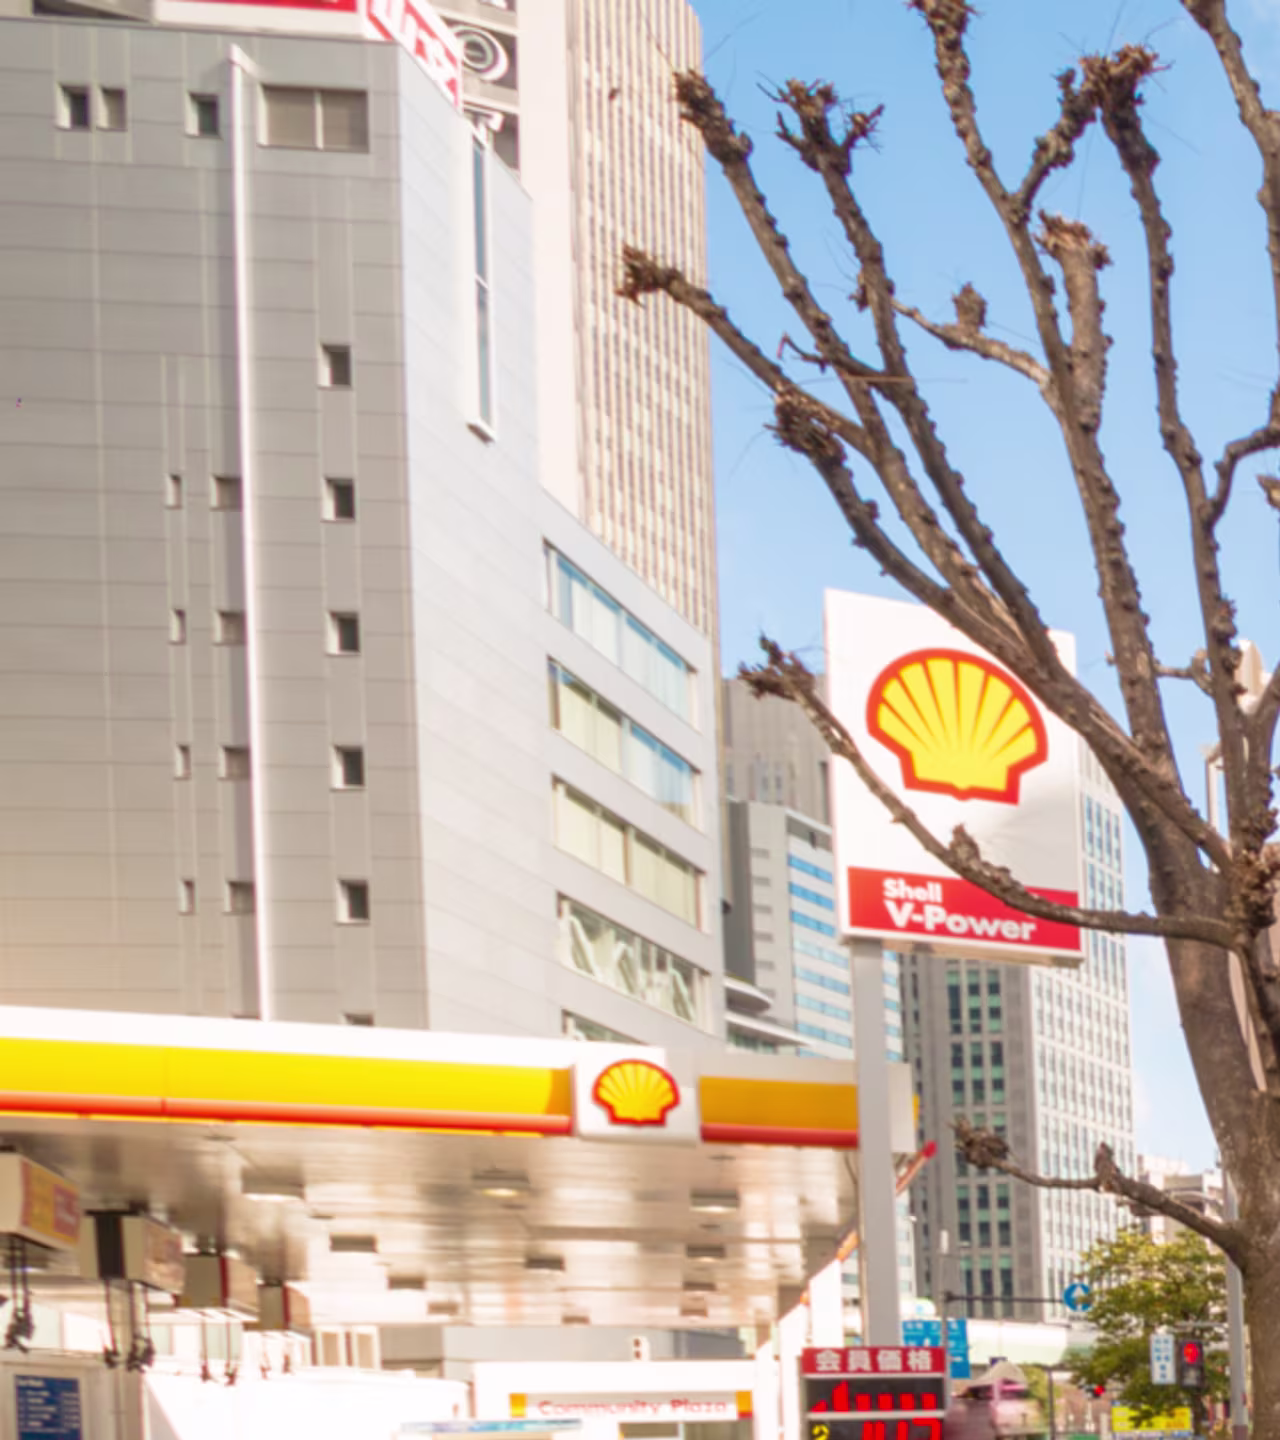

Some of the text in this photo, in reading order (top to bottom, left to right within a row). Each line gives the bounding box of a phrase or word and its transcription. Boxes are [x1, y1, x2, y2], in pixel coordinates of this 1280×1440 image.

[883, 877, 943, 904] Shell
[884, 899, 1037, 942] V-Power
[815, 1349, 933, 1373] 会員価格
[537, 1398, 728, 1416] Community Plaza
